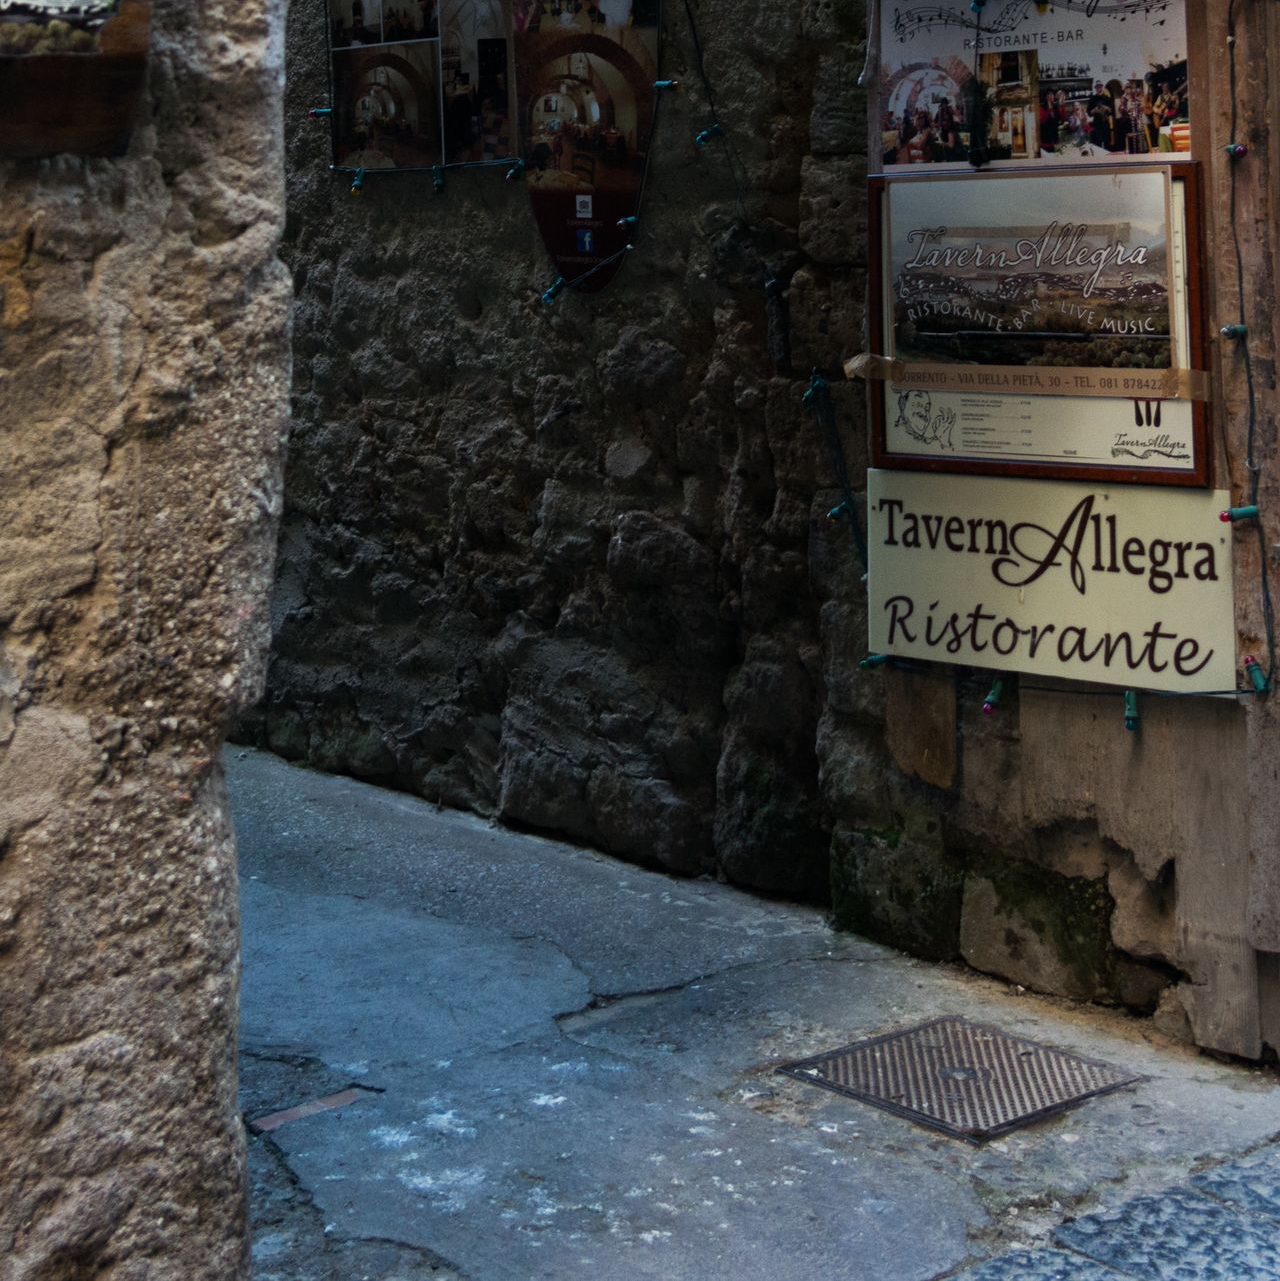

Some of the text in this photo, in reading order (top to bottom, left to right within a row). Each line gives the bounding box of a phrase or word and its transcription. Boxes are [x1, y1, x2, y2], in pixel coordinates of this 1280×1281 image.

[907, 298, 1156, 335] RISTORANTE BAR LIVE MUSIC
[957, 373, 975, 384] VIA
[977, 374, 1010, 386] DELLA
[1048, 376, 1062, 387] 30
[1073, 376, 1096, 389] TEL.
[1099, 378, 1119, 389] 081
[883, 595, 1215, 677] Ristorante
